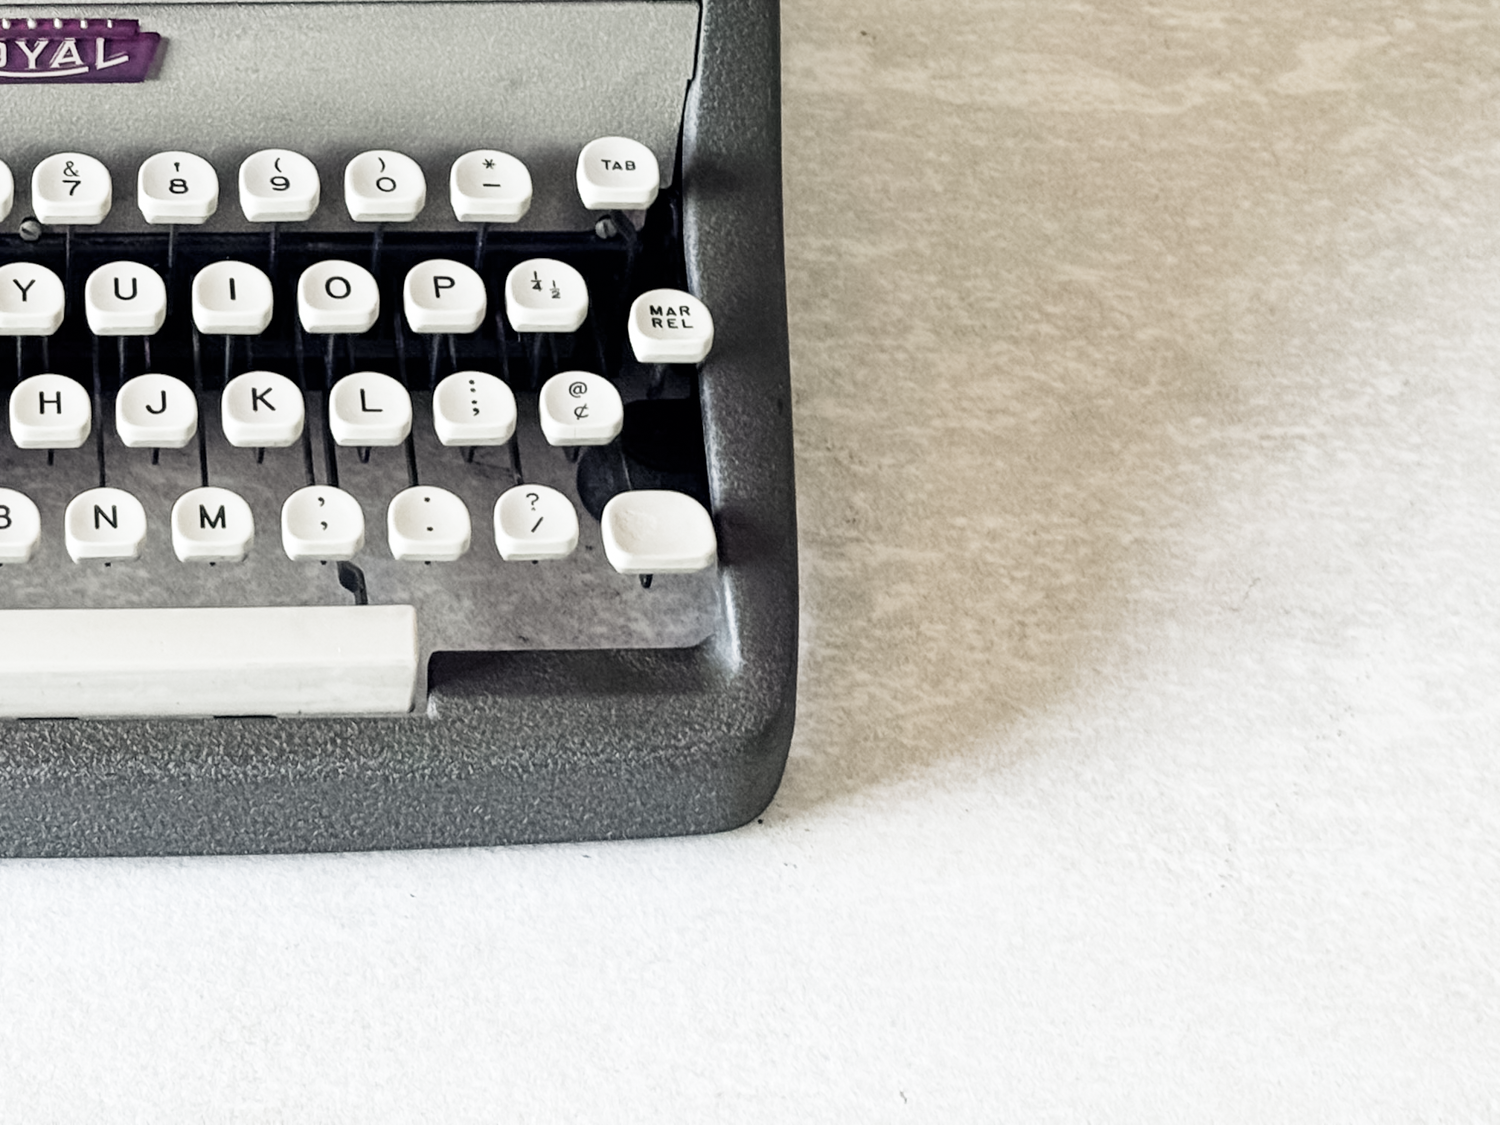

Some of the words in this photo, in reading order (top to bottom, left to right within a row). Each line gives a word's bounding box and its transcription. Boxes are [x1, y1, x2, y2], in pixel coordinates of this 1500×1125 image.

[63, 160, 79, 177] &
[600, 159, 636, 171] TAB
[62, 179, 82, 197] 7
[168, 178, 189, 195] 8
[269, 175, 291, 192] 9
[375, 176, 397, 193] 0
[12, 278, 36, 302] Y
[113, 277, 138, 301] U
[229, 277, 236, 301] I
[324, 276, 352, 300] O
[433, 275, 456, 299] P
[649, 304, 691, 317] MAR
[651, 317, 693, 329] REL
[251, 387, 276, 412] K
[359, 388, 383, 413] L
[568, 381, 588, 398] @
[38, 391, 62, 415] H
[145, 390, 167, 415] J
[525, 492, 540, 512] ?
[93, 504, 118, 530] N
[199, 504, 227, 530] M
